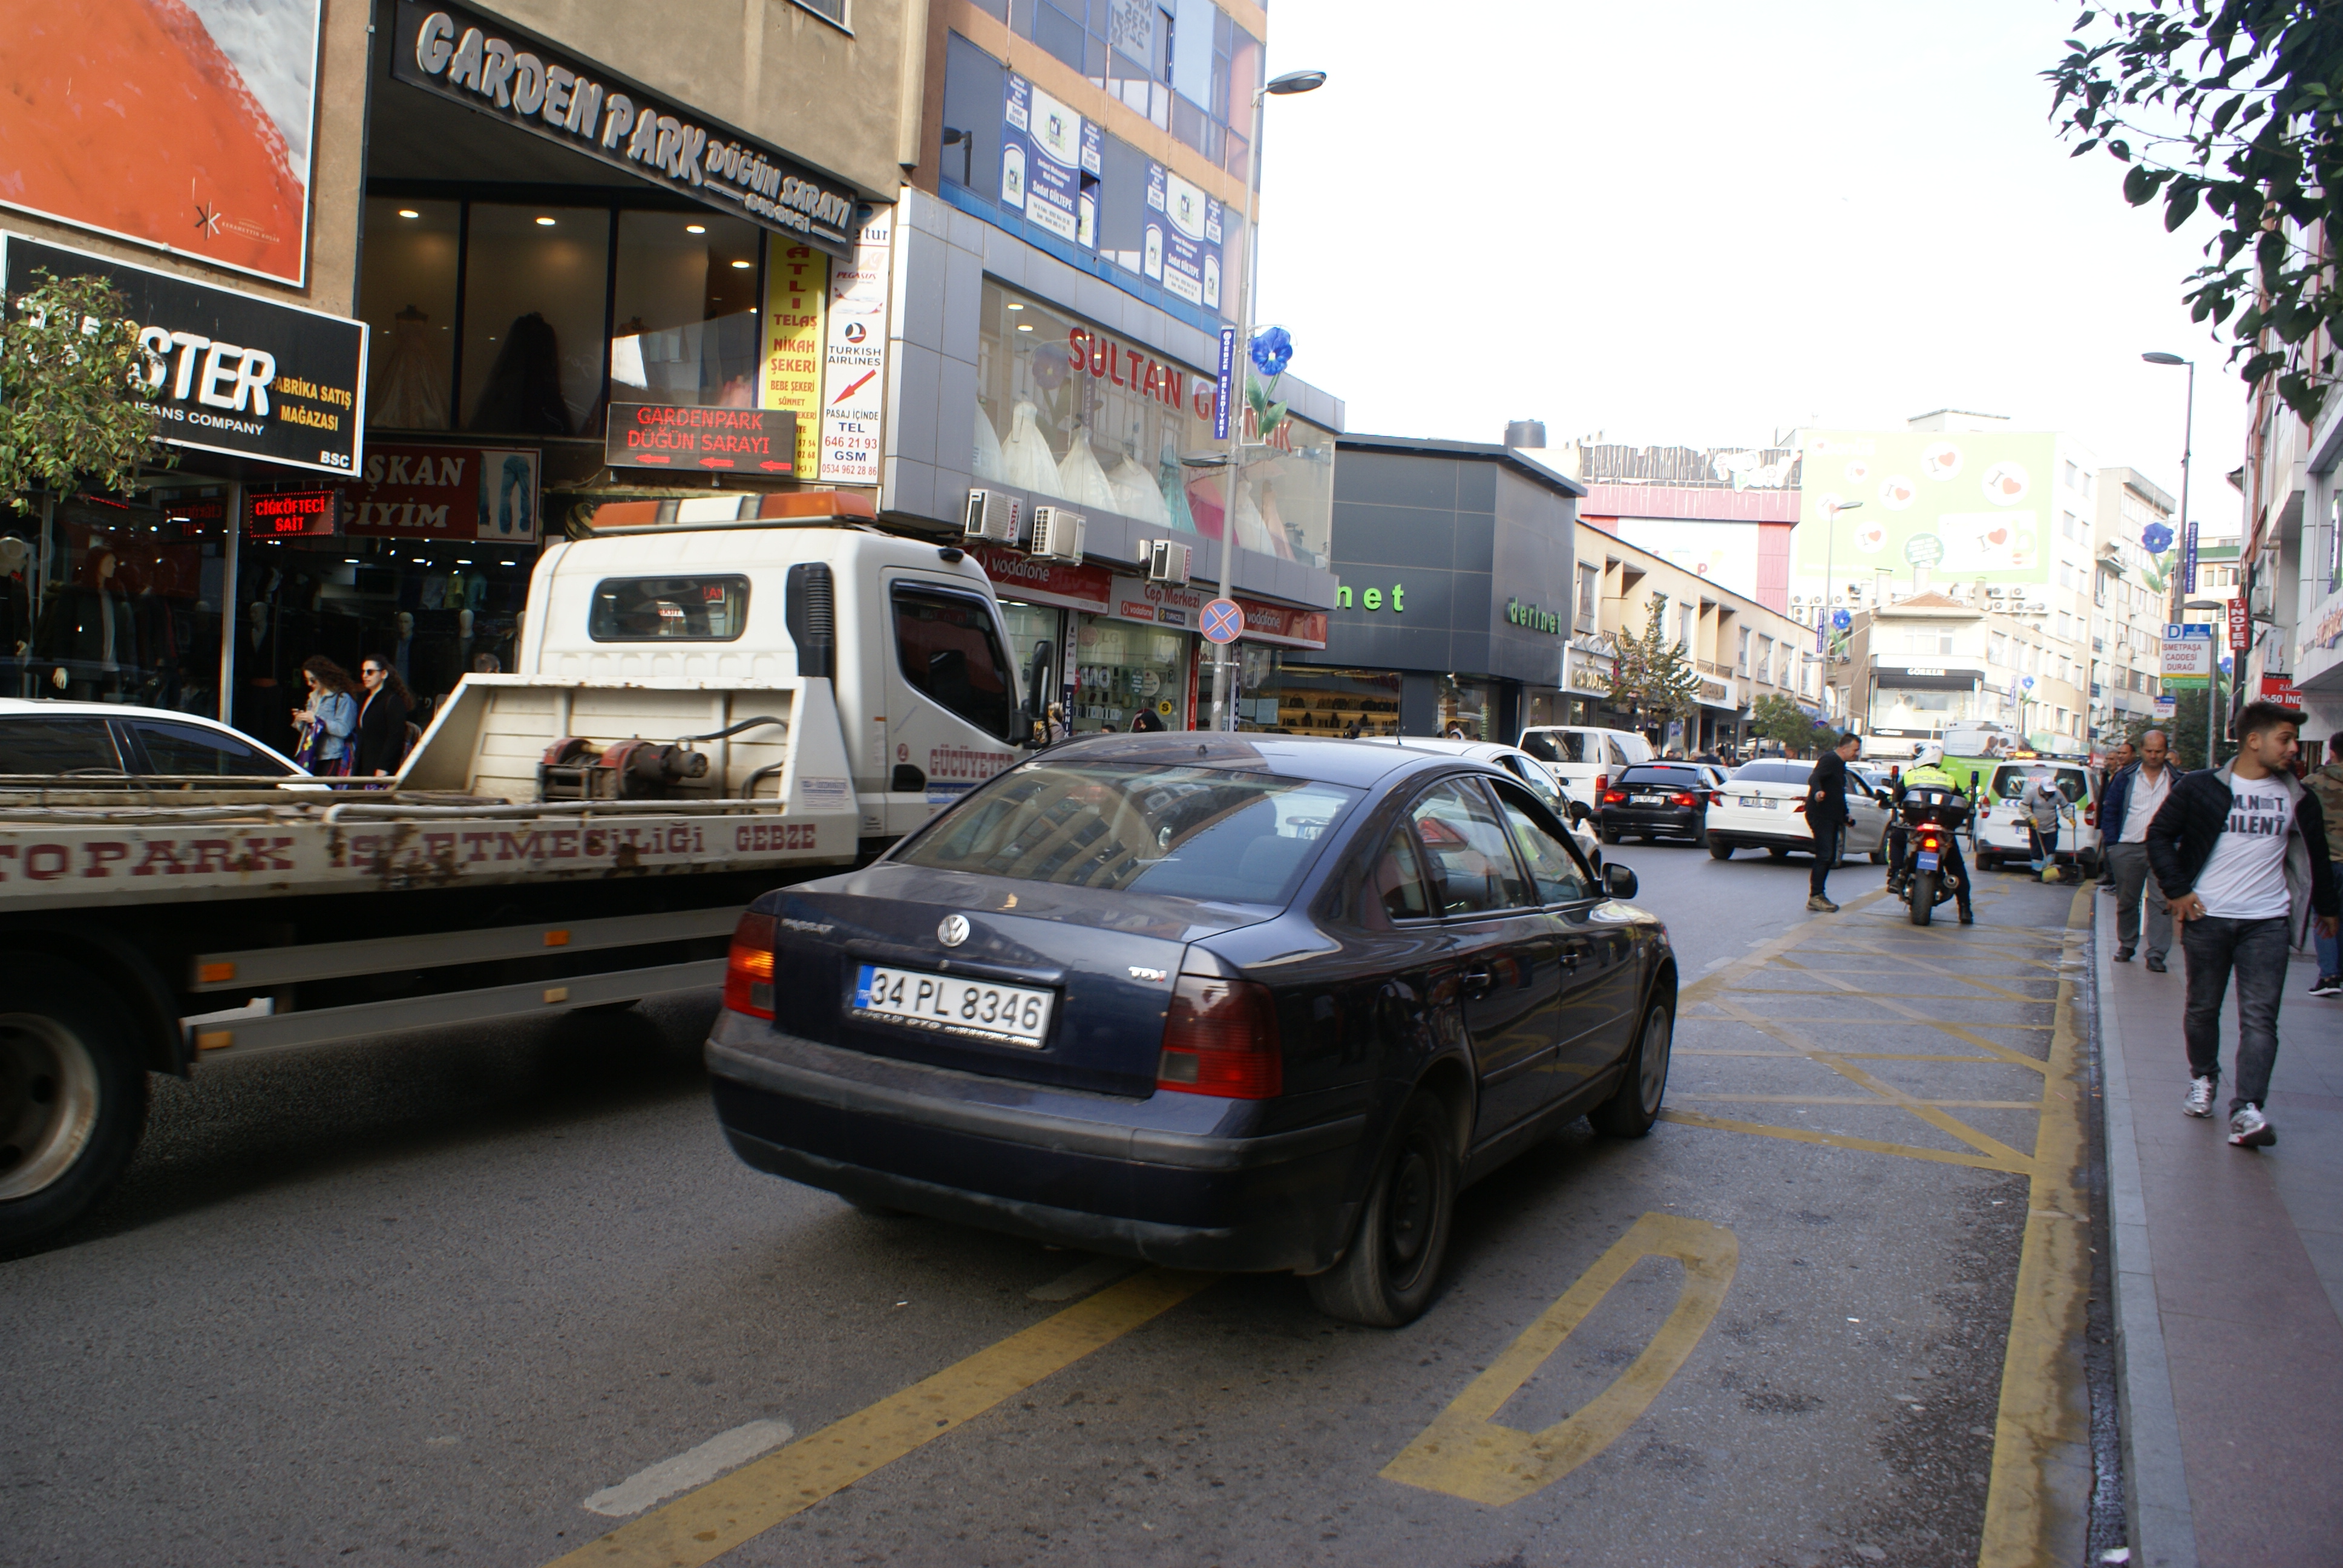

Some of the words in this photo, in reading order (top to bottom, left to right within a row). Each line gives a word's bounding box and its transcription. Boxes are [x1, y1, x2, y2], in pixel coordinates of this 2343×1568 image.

[417, 12, 603, 139] GARDEN
[603, 94, 707, 186] PARK
[706, 140, 782, 195] DÜĞÜN
[782, 176, 851, 229] SARAYI
[865, 227, 888, 240] tur
[787, 242, 810, 309] ATLI
[836, 271, 877, 279] PEGASUS
[773, 314, 818, 330] TELAŞ
[773, 336, 815, 353] NİKAH
[829, 346, 881, 356] TURKISH
[771, 357, 816, 374] ŞEKERİ
[828, 356, 880, 367] AIRLINES
[1068, 327, 1182, 410] SULTAN
[126, 326, 276, 416] STER
[770, 381, 789, 391] BEBE
[791, 381, 814, 393] ŞEKERİ
[320, 385, 352, 411] SATIŞ
[188, 412, 264, 436] COMPANY
[280, 405, 339, 431] MAĞAZASI
[637, 408, 763, 430] GARDENPARK
[796, 411, 817, 420] EKERİ
[826, 409, 850, 420] PASAJ
[852, 409, 879, 422] İÇİNDE
[839, 423, 865, 433] TEL
[628, 426, 695, 449] DÜĞÜN
[701, 435, 770, 454] SARAYI
[825, 436, 845, 447] 646
[848, 437, 860, 448] 21
[864, 438, 877, 449] 93
[320, 451, 350, 468] BSC
[834, 451, 867, 462] GSM
[822, 464, 841, 473] 0534
[842, 465, 855, 474] 962
[856, 465, 867, 475] 28
[868, 466, 877, 475] 86
[275, 514, 304, 532] SAİT
[1009, 503, 1018, 538] VESTEL
[991, 557, 1050, 583] vodafone
[1144, 584, 1161, 606] Cep
[1165, 588, 1200, 608] Merkezi
[1335, 583, 1404, 612] net
[1130, 606, 1153, 618] vodafone
[1247, 612, 1280, 627] vodafone
[1509, 596, 1562, 635] derinet
[2168, 626, 2180, 638] D
[2230, 609, 2246, 648] NOTER
[2165, 652, 2197, 661] CADDESİ
[1907, 668, 1946, 676] GÖRKEM
[2167, 662, 2195, 671] DURAĞI
[2261, 694, 2283, 704] %50
[735, 823, 816, 852] GEBZE
[871, 973, 905, 1008] 34
[914, 979, 949, 1017] PL
[961, 986, 1043, 1031] 8346
